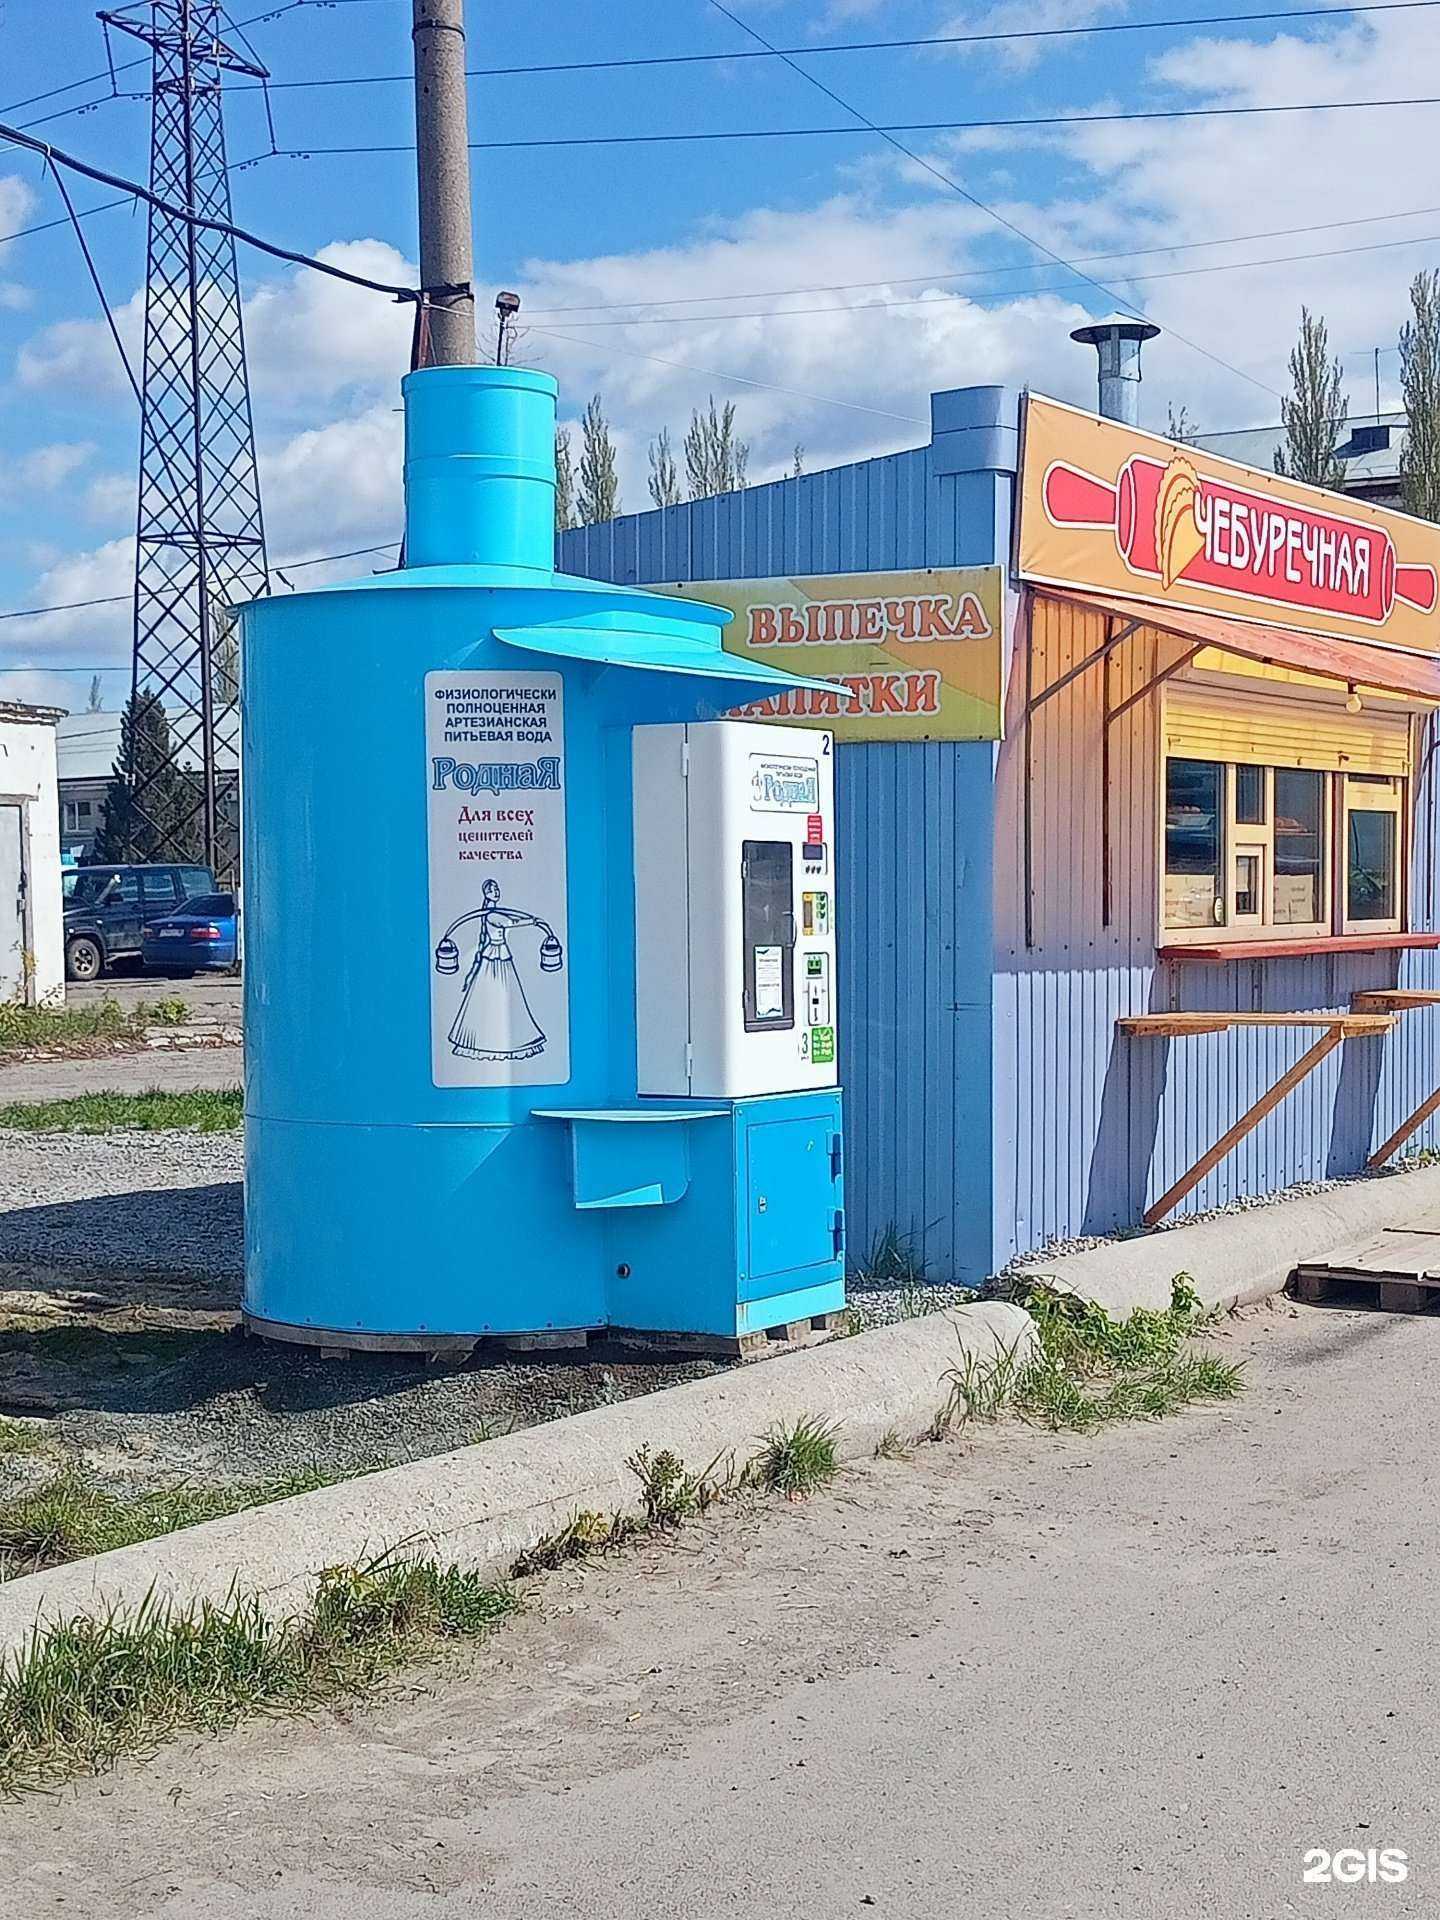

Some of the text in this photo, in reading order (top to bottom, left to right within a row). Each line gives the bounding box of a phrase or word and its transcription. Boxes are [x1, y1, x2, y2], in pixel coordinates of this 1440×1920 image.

[1193, 490, 1372, 598] ЧЕБУРЕЧНАЯ
[749, 595, 990, 645] ВЫПЕЧКА
[434, 688, 557, 700] ФИЗИОЛОГИЧЕСКИ
[721, 674, 938, 717] АПИТКИ
[446, 703, 545, 715] ПОЛНОЦЕННАЯ
[445, 717, 547, 728] АРТЕЗИАНСКАЯ
[444, 731, 553, 743] ПИТЬЕВАЯ ВОДА
[822, 734, 830, 755] 2
[458, 806, 534, 825] Для всех
[458, 829, 534, 843] ценителей
[458, 850, 523, 860] качества
